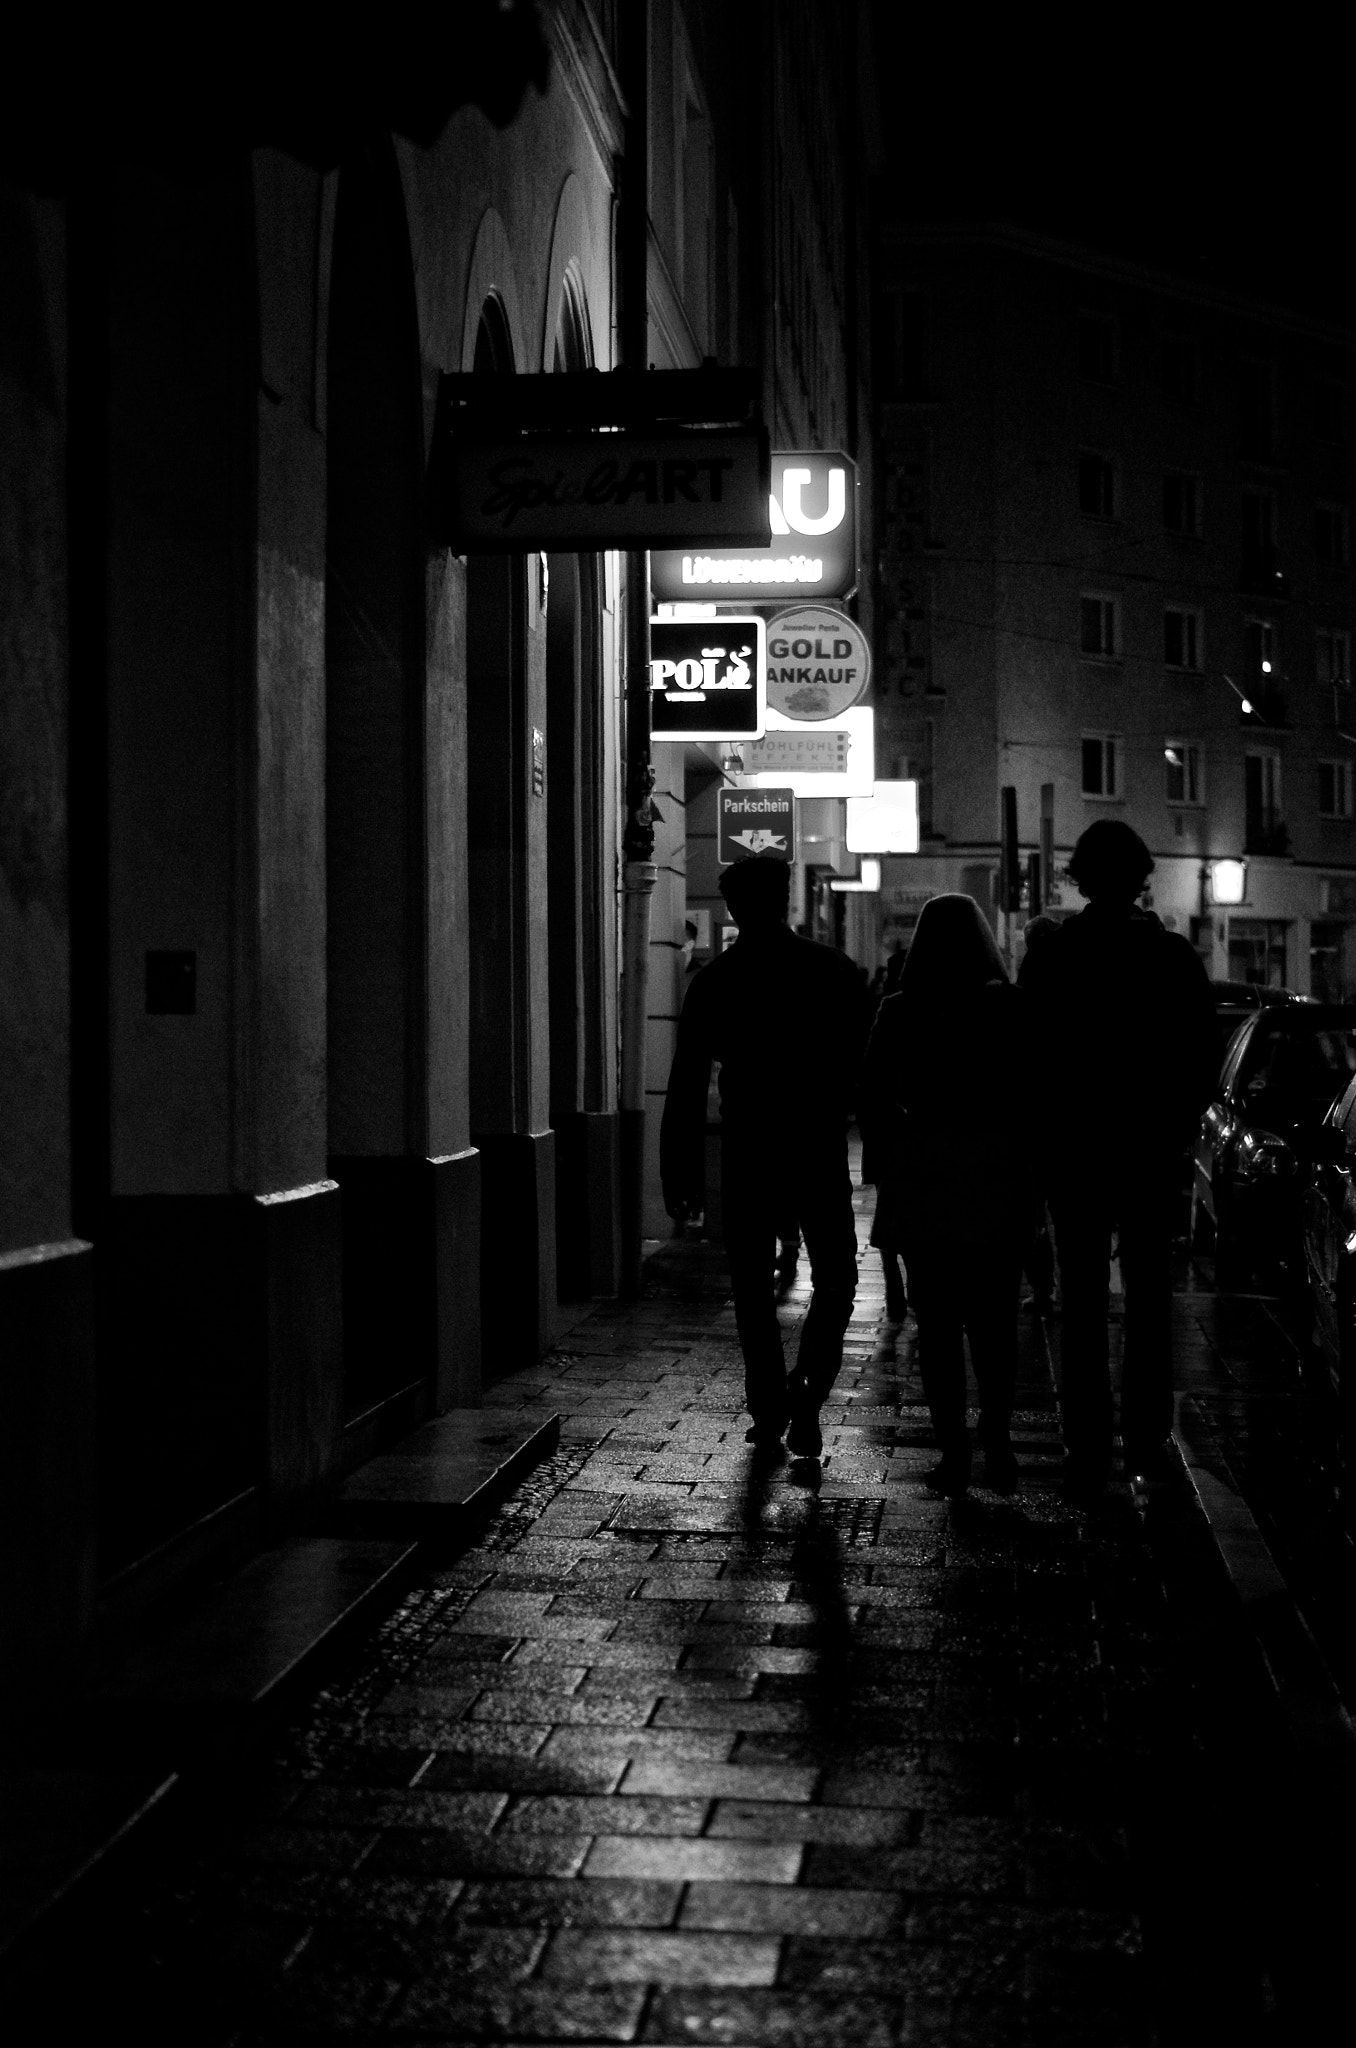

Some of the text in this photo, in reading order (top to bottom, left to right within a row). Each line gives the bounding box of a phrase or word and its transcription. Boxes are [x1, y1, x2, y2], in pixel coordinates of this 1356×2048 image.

[769, 638, 853, 660] GOLD
[766, 667, 857, 684] ANKAUF
[751, 740, 834, 751] WOHLFÜHL
[751, 753, 834, 761] EFFEKT
[724, 798, 789, 813] Parkschein
